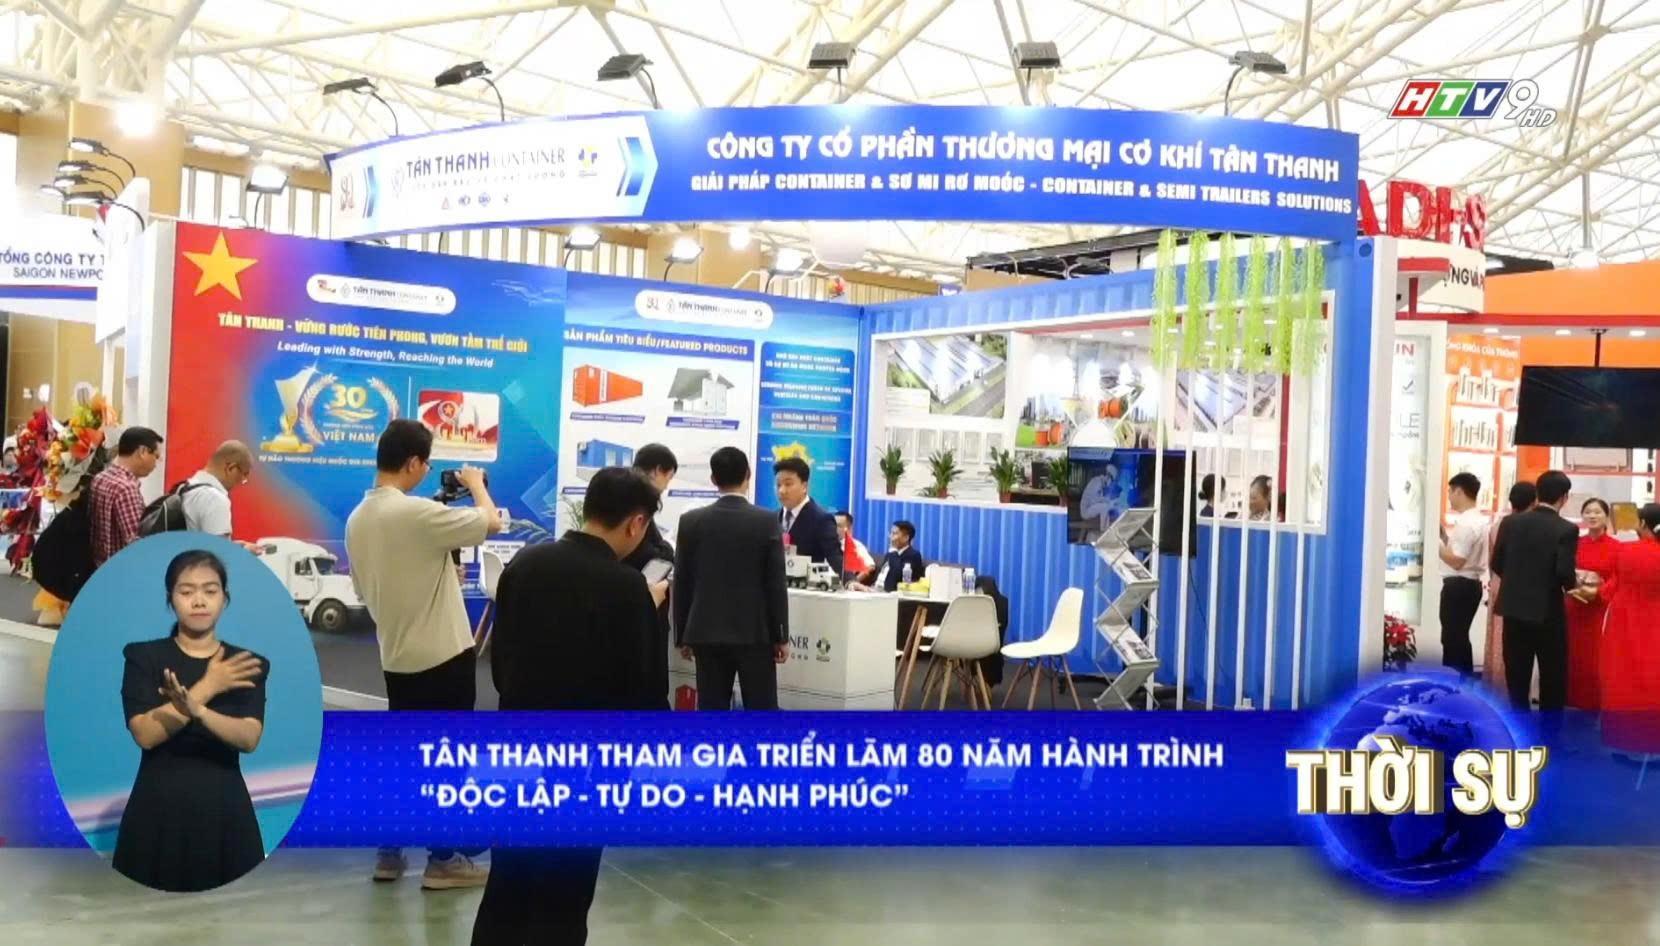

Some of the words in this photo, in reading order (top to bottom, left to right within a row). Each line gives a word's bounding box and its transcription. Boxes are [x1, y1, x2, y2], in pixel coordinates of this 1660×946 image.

[435, 151, 490, 174] THANH
[706, 131, 774, 159] CÔNG
[780, 134, 813, 161] TY
[818, 125, 853, 158] CỔ
[860, 126, 935, 160] PHẦN
[942, 131, 1055, 161] THƯƠNG
[1062, 138, 1111, 170] MẠI
[1119, 138, 1152, 166] CƠ
[1159, 140, 1203, 169] KHÍ
[1209, 143, 1257, 174] TÂN
[1263, 152, 1339, 183] THANH
[691, 171, 723, 191] GIẢI
[728, 169, 770, 190] PHÁP
[775, 173, 866, 190] CONTAINER
[871, 175, 884, 189] &
[888, 172, 913, 189] SƠ
[917, 174, 938, 190] MI
[944, 172, 969, 190] RƠ
[974, 171, 1025, 192] MOÓC
[1042, 177, 1134, 196] CONTAINER
[1139, 184, 1151, 198] &
[1156, 181, 1196, 200] SEMI
[1200, 184, 1270, 206] TRAILERS
[1276, 191, 1352, 214] SOLUTIONS
[34, 251, 73, 265] CÔNG
[79, 253, 96, 265] TY
[13, 267, 56, 279] SAIGON
[60, 268, 104, 280] NEWPO
[218, 311, 242, 328] TÂN
[245, 315, 284, 331] THANH
[277, 341, 321, 356] Leading
[323, 344, 346, 356] with
[349, 346, 396, 361] Strength,
[399, 351, 444, 366] Reaching
[447, 353, 463, 365] the
[466, 355, 494, 368] World
[703, 343, 748, 355] PRODUCTS
[332, 384, 366, 408] 30
[323, 429, 345, 442] VIỆT
[349, 431, 375, 443] NAM
[789, 635, 809, 650] NER
